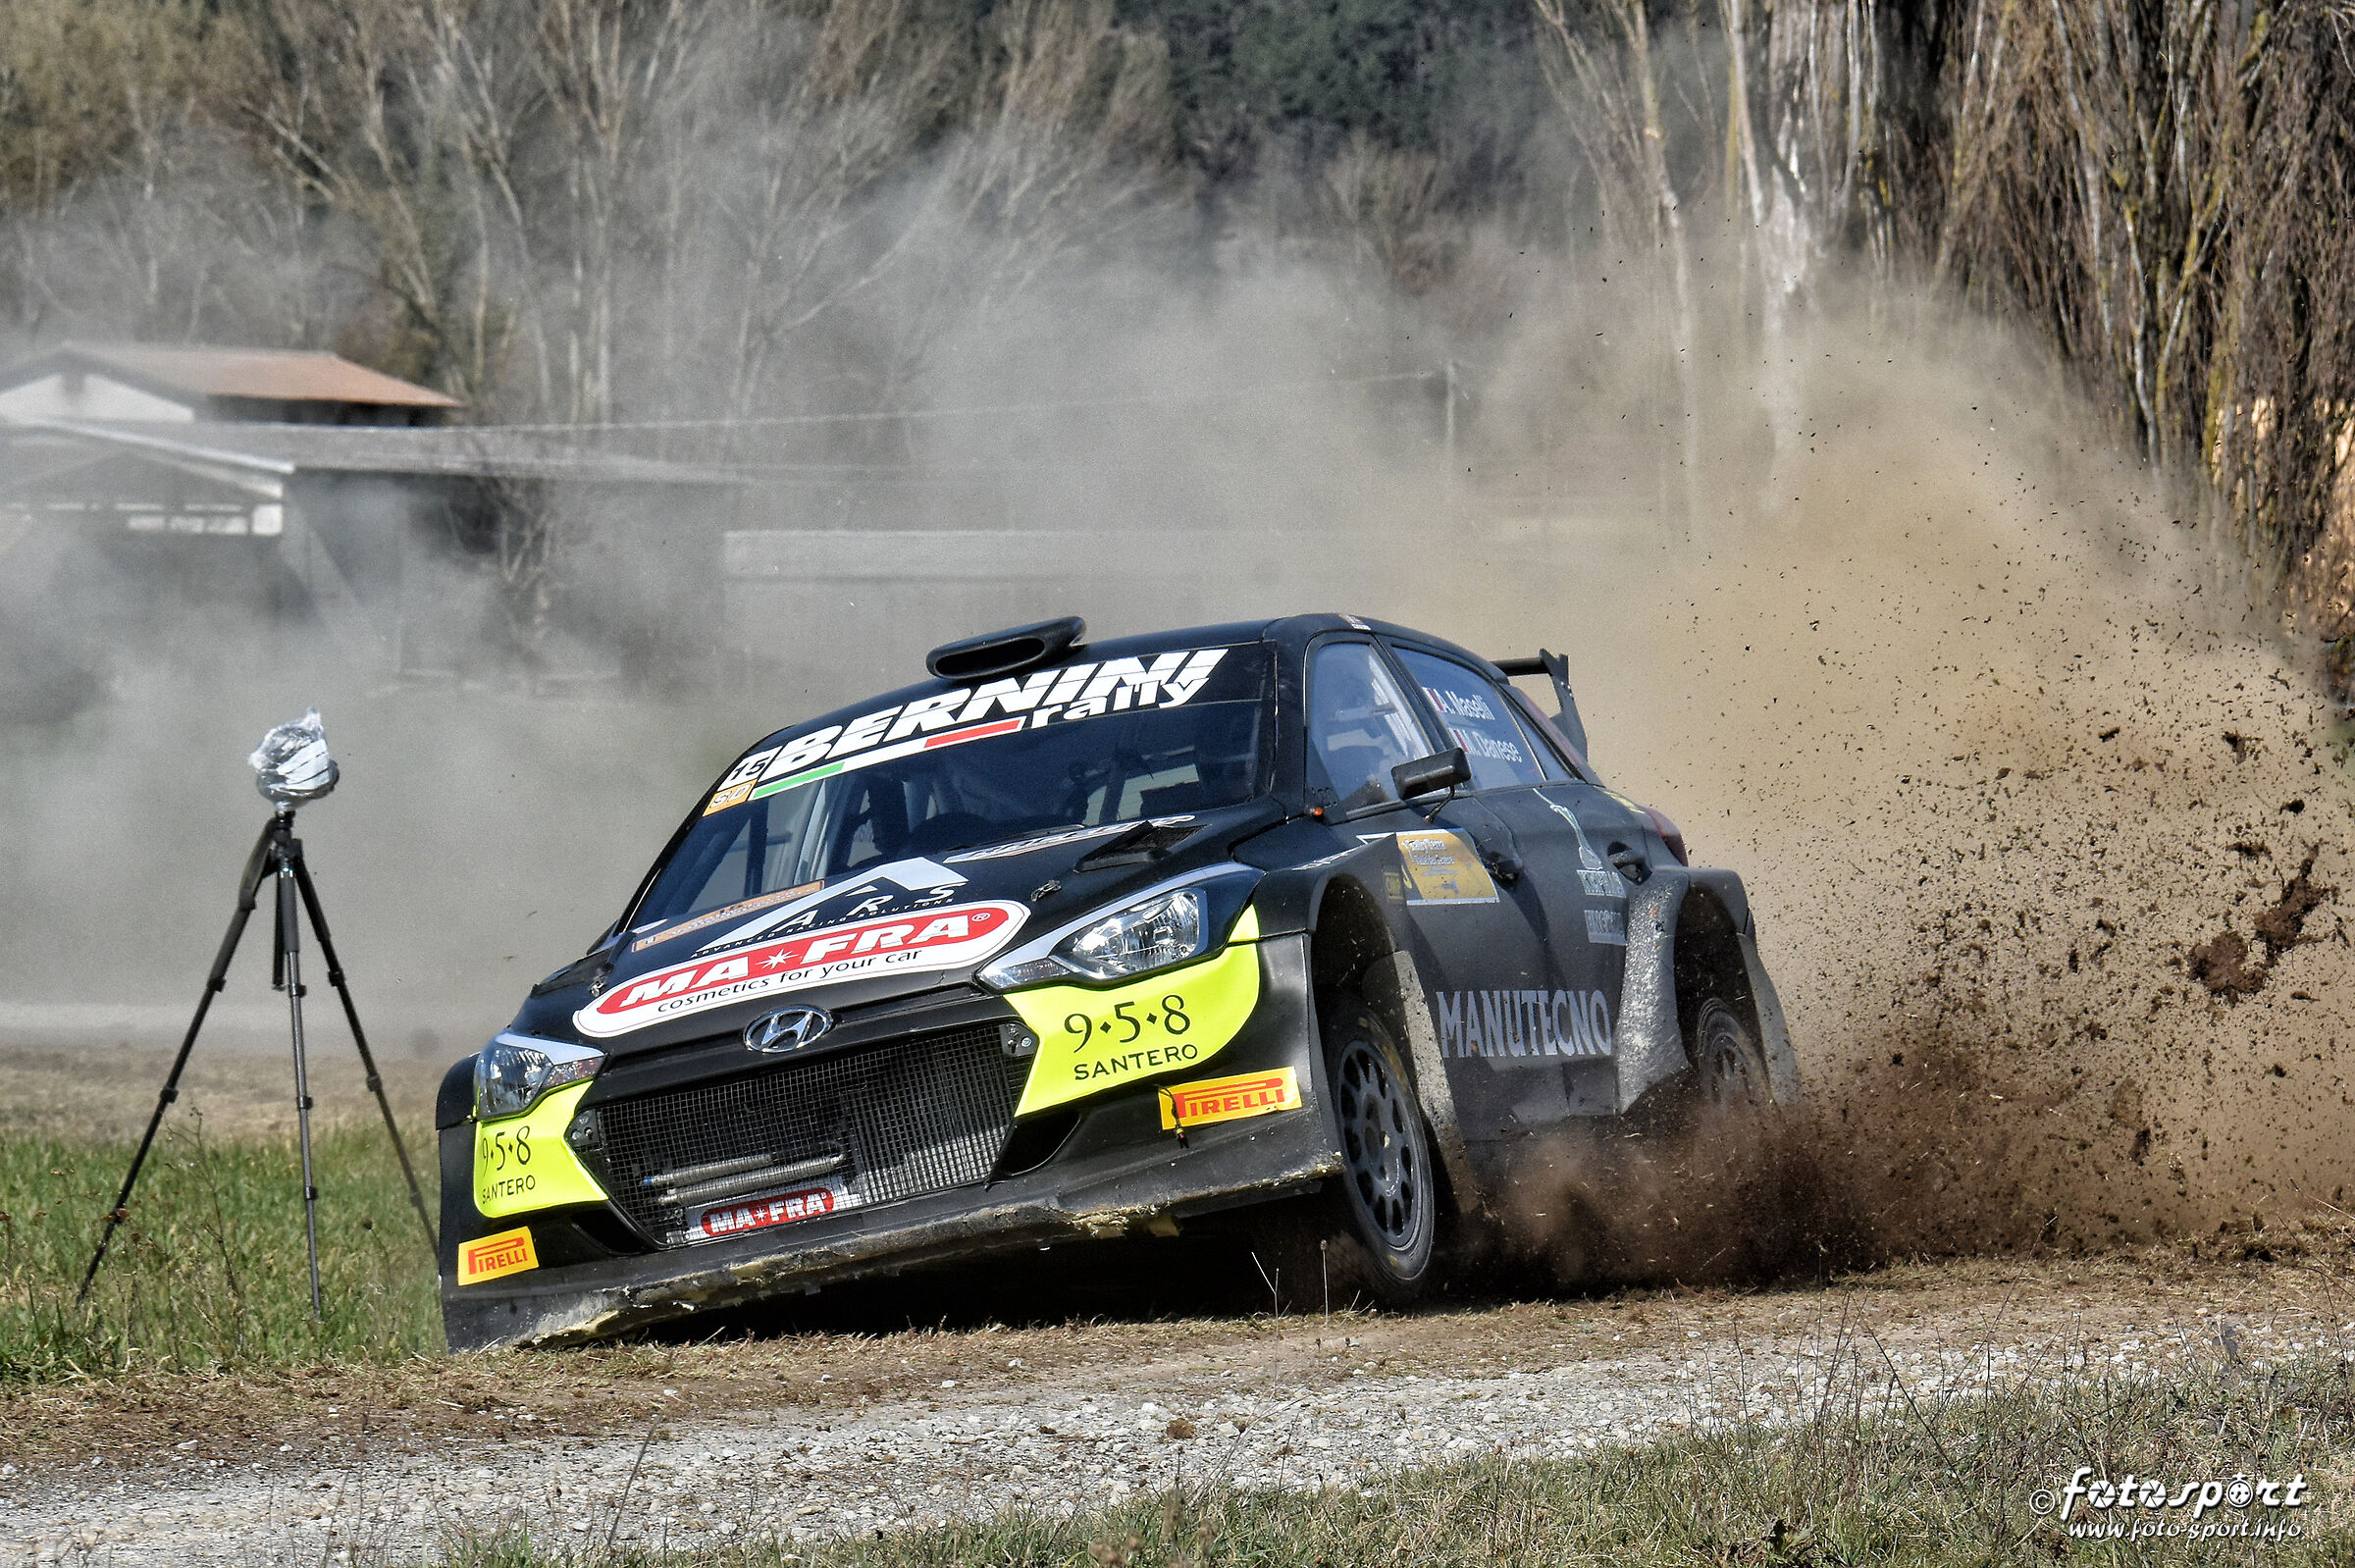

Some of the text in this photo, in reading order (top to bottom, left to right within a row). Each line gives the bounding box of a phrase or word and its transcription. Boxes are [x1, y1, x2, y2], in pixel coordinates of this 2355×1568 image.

[758, 649, 1229, 782] BERNINI
[1031, 677, 1209, 729] rally
[730, 756, 770, 781] 15
[709, 782, 752, 809] SD
[691, 898, 955, 959] ADVANCED RACING SOLUTIONS
[658, 948, 922, 1014] cosmetics for your car
[1436, 989, 1611, 1058] MANUTECNO
[1073, 1043, 1198, 1080] SANTERO
[1173, 1077, 1285, 1119] PIRELLI
[482, 1175, 536, 1205] SANTERO
[468, 1236, 528, 1275] PIRELLI
